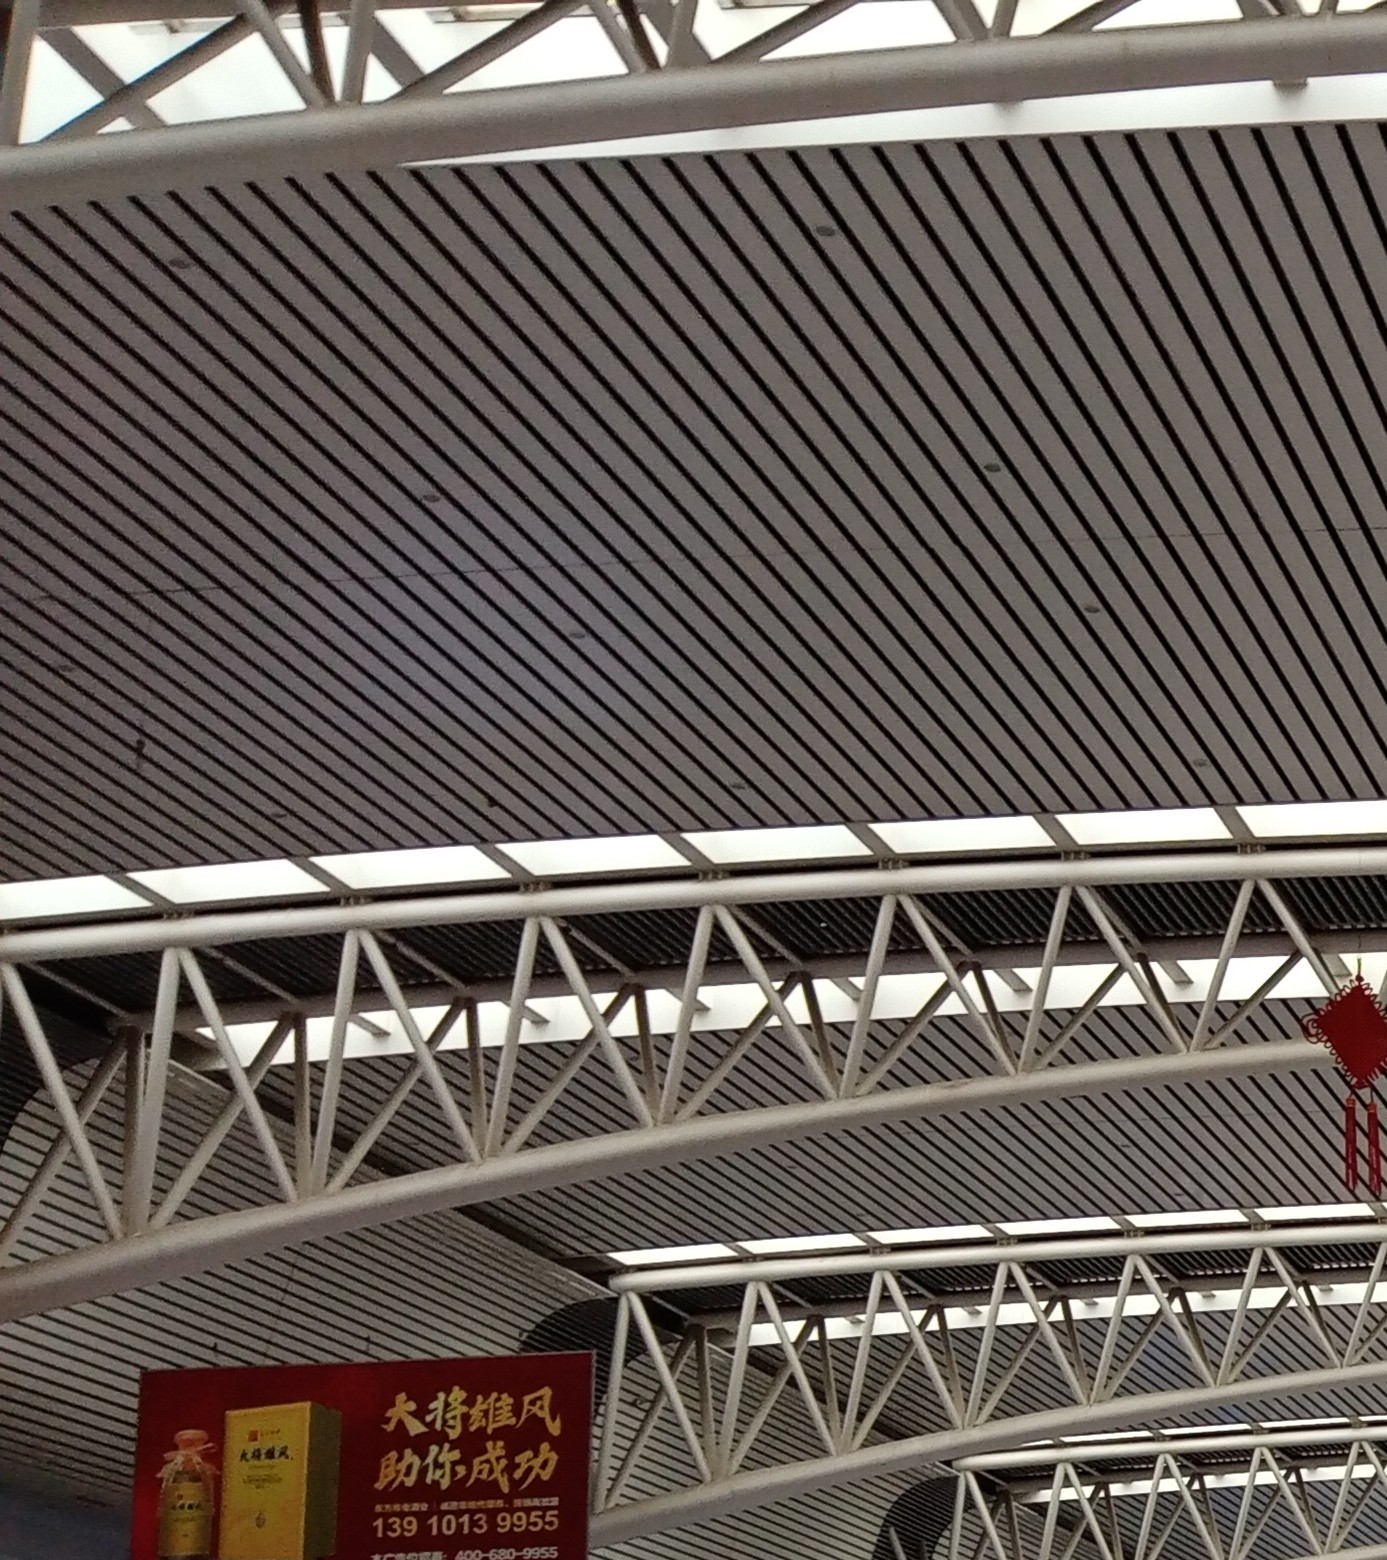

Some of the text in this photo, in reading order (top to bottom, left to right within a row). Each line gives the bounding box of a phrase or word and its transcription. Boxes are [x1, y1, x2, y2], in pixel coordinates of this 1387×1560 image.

[381, 1385, 562, 1441] 大将雄风
[373, 1440, 559, 1494] 助你成功
[372, 1509, 560, 1538] 139 1013 9955
